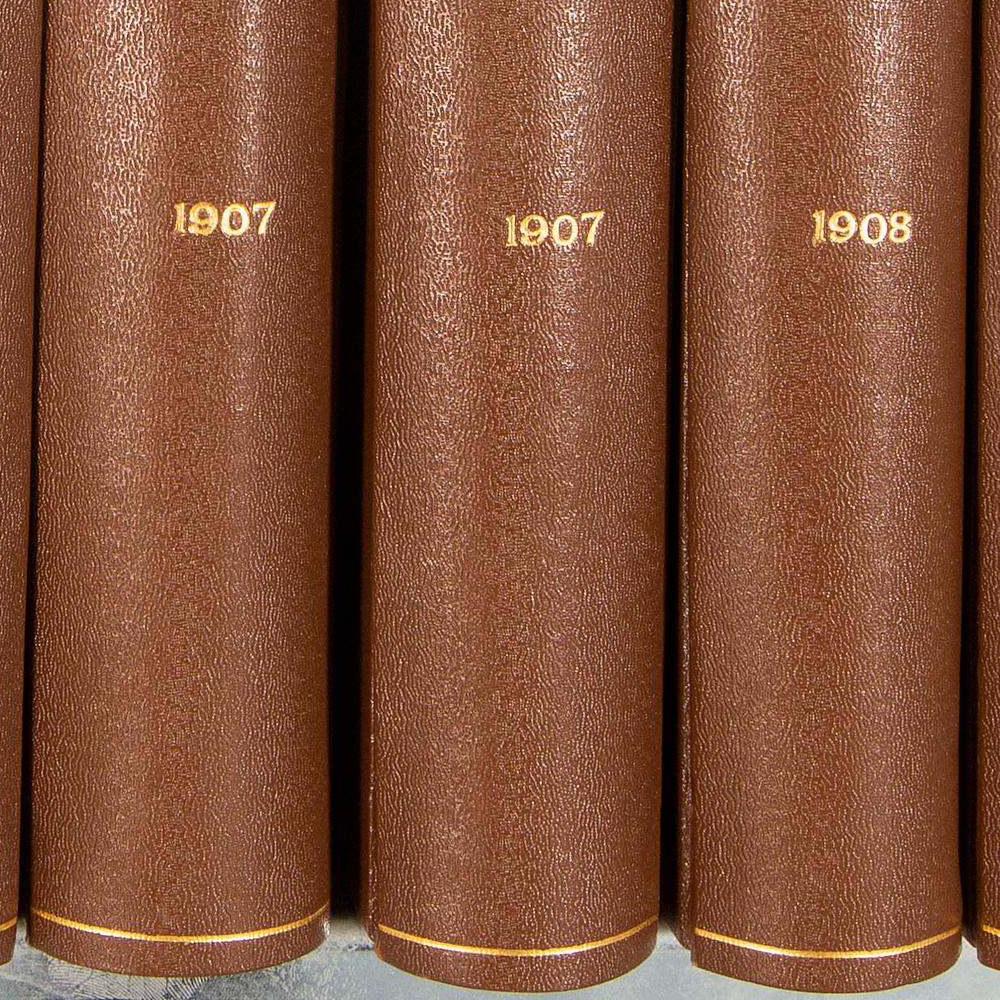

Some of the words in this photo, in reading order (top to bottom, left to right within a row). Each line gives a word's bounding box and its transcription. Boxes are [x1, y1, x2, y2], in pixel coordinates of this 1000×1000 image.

[174, 201, 276, 237] 1907
[505, 210, 604, 248] 1907
[812, 210, 912, 246] 1908
